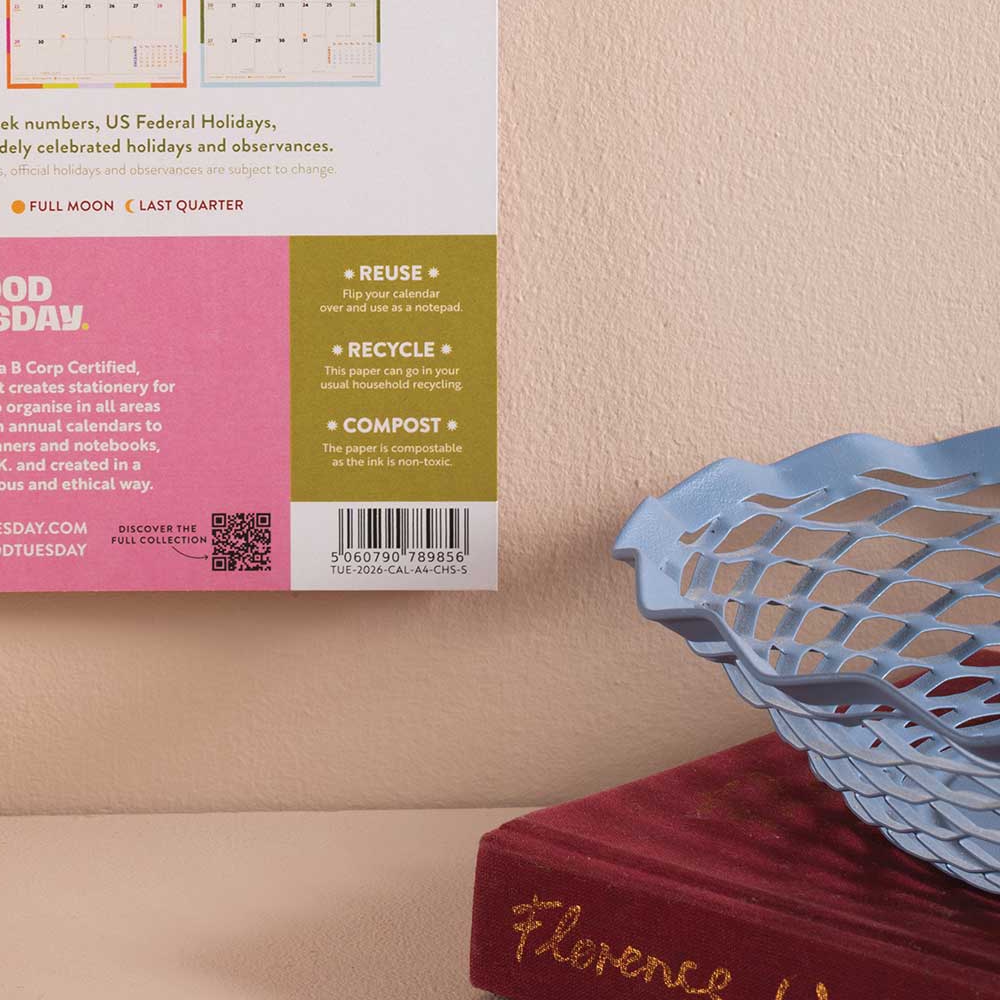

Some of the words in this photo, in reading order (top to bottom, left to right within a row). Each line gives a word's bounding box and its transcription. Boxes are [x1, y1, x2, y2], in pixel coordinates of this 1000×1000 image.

[25, 115, 100, 132] numbers,
[106, 114, 130, 129] US
[137, 114, 194, 129] Federal
[202, 114, 276, 134] Holidays,
[37, 138, 120, 153] celebrated
[127, 138, 192, 158] holidays
[198, 138, 226, 152] and
[232, 138, 333, 152] observances.
[30, 201, 63, 211] FULL
[68, 200, 113, 211] MOON
[140, 200, 172, 211] LAST
[176, 200, 243, 213] QUARTER
[360, 264, 422, 280] REUSE
[343, 289, 362, 300] Flip
[365, 291, 390, 301] your
[392, 289, 440, 298] calendar
[320, 304, 344, 312] over
[346, 303, 368, 312] and
[415, 302, 463, 314] notepad.
[349, 342, 434, 357] RECYCLE
[12, 361, 21, 374] B
[26, 361, 64, 377] Corp
[68, 360, 140, 376] Certified,
[325, 366, 346, 376] This
[349, 368, 380, 378] paper
[384, 368, 402, 376] can
[406, 368, 419, 378] go
[422, 366, 432, 375] in
[435, 368, 460, 378] your
[9, 382, 64, 394] creates
[69, 380, 148, 396] stationery
[153, 380, 175, 392] for
[321, 380, 349, 389] usual
[352, 380, 409, 389] household
[413, 379, 463, 392] recycling.
[343, 417, 441, 433] COMPOST
[40, 439, 69, 452] and
[74, 438, 160, 453] notebooks,
[28, 478, 58, 490] and
[62, 477, 116, 490] ethical
[120, 480, 153, 493] way.
[119, 525, 173, 534] DISCOVER
[140, 536, 206, 544] COLLECTION
[331, 552, 339, 562] 5
[344, 552, 400, 562] 060790
[408, 552, 464, 562] 789856
[331, 565, 467, 574] TUE-2026-CAL-A4-CHS-S
[512, 895, 732, 1000] Florence
